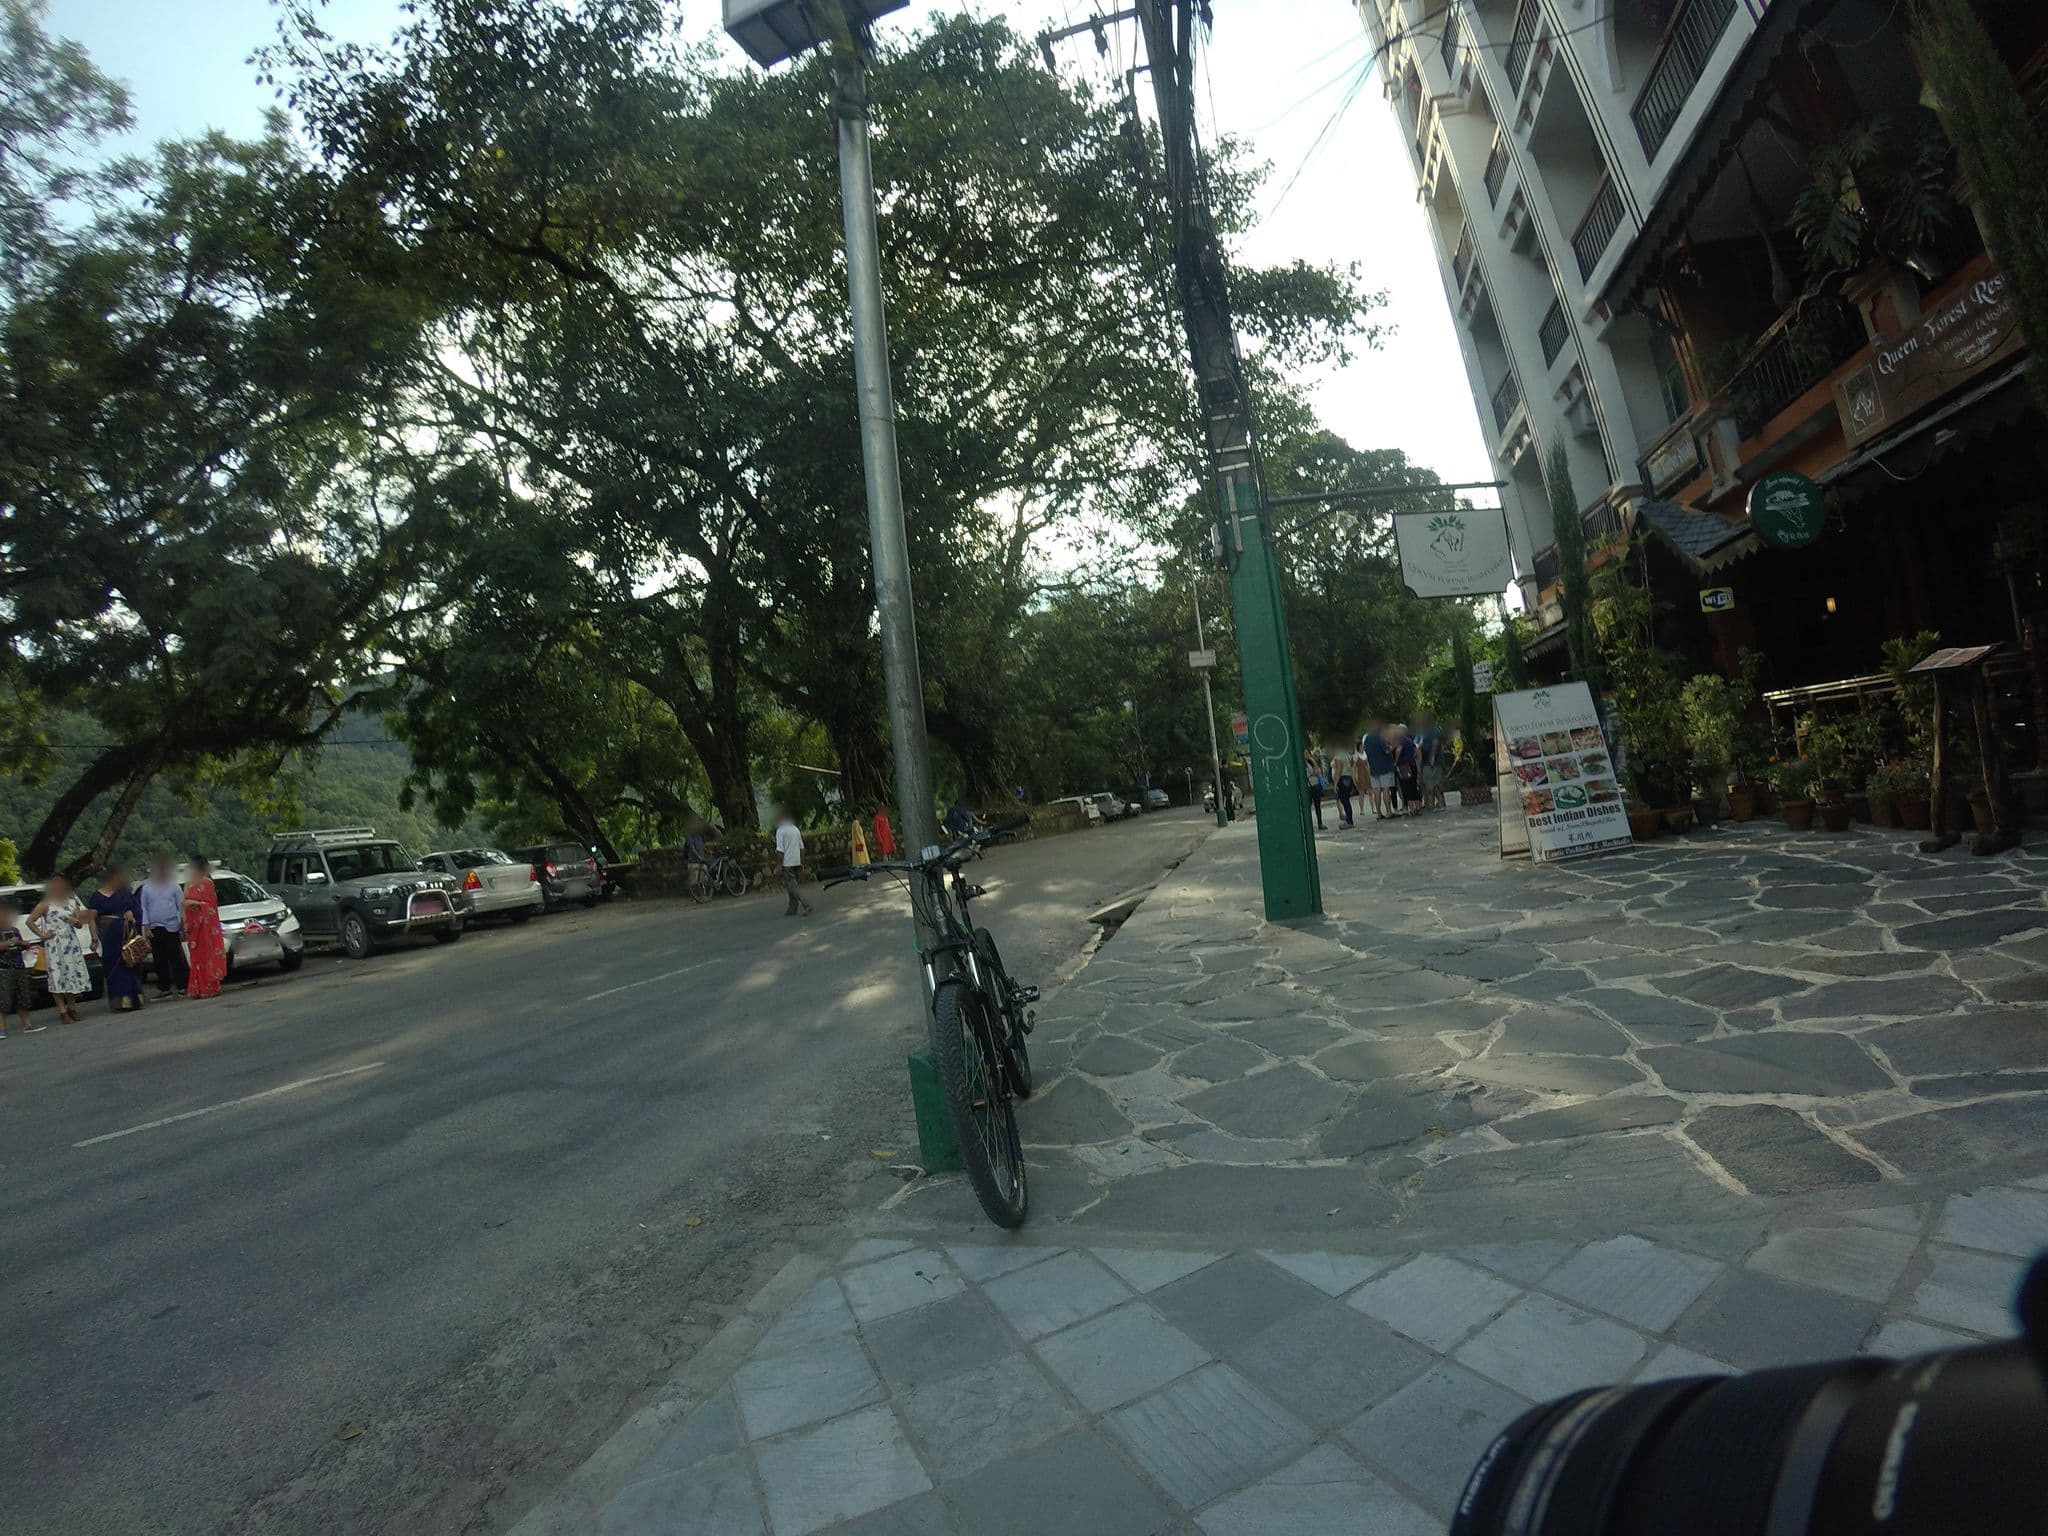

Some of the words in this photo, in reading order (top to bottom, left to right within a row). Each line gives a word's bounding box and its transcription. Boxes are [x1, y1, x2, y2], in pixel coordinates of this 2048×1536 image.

[1877, 336, 1918, 376] Queen
[1924, 300, 1968, 344] Forest
[1529, 815, 1552, 828] Best
[1553, 808, 1586, 824] Indian
[1586, 803, 1622, 819] Dishes
